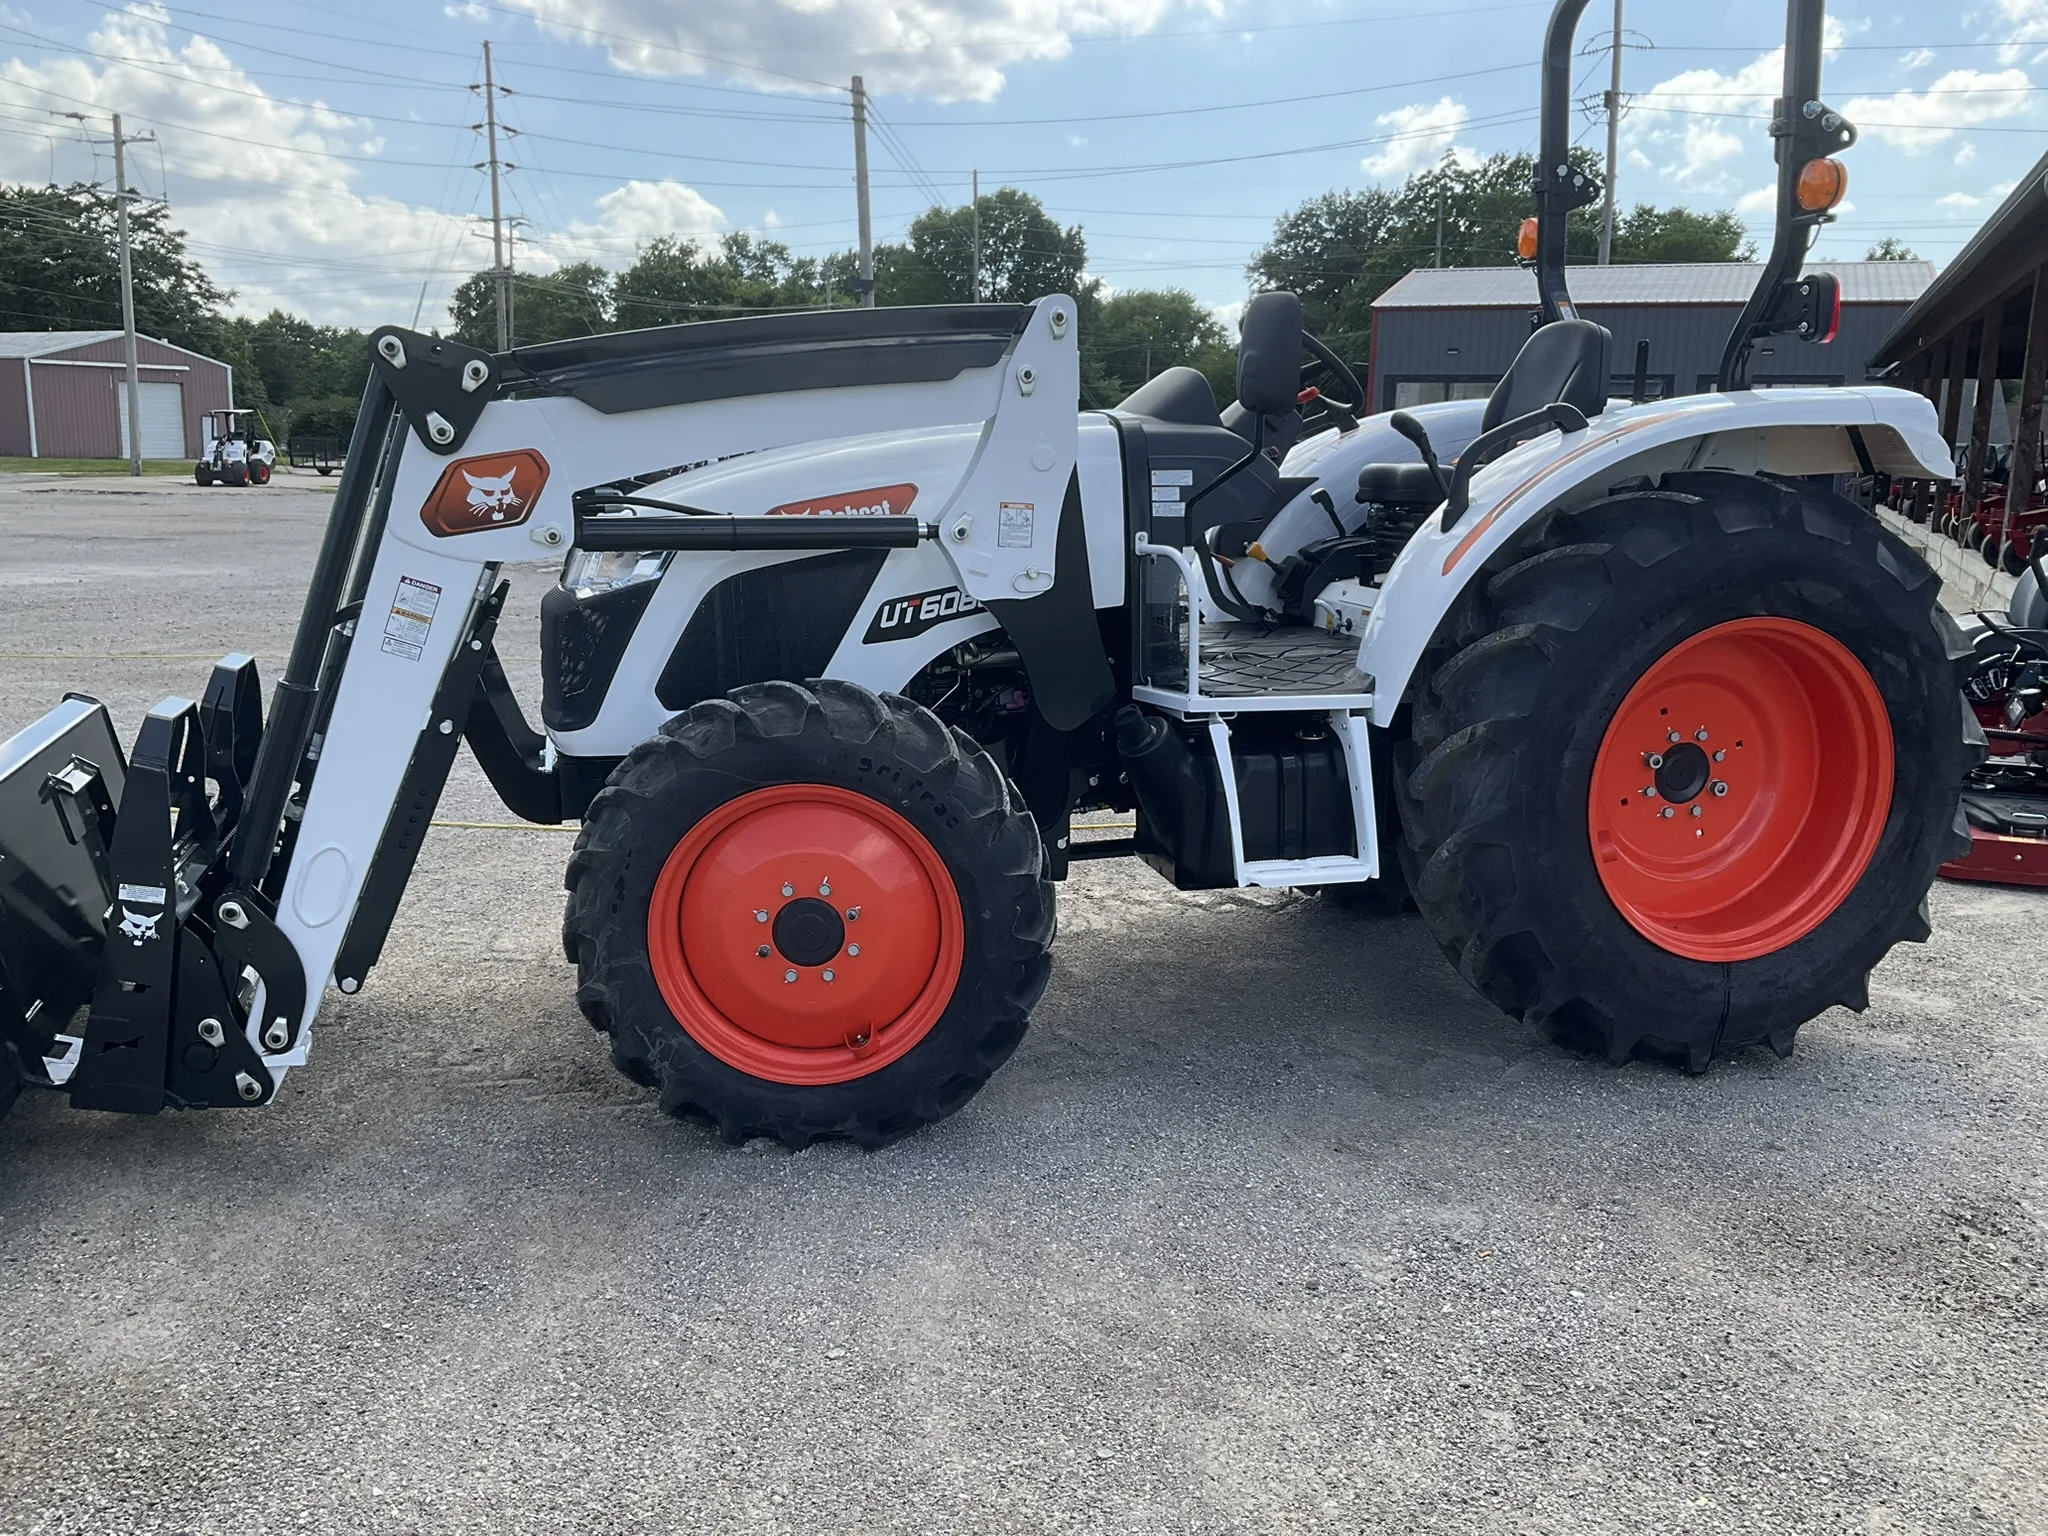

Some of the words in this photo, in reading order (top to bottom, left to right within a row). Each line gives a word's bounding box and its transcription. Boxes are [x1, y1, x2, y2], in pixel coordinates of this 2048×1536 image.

[819, 500, 890, 516] bcat
[411, 579, 438, 592] DANGER
[400, 610, 429, 623] WARNING
